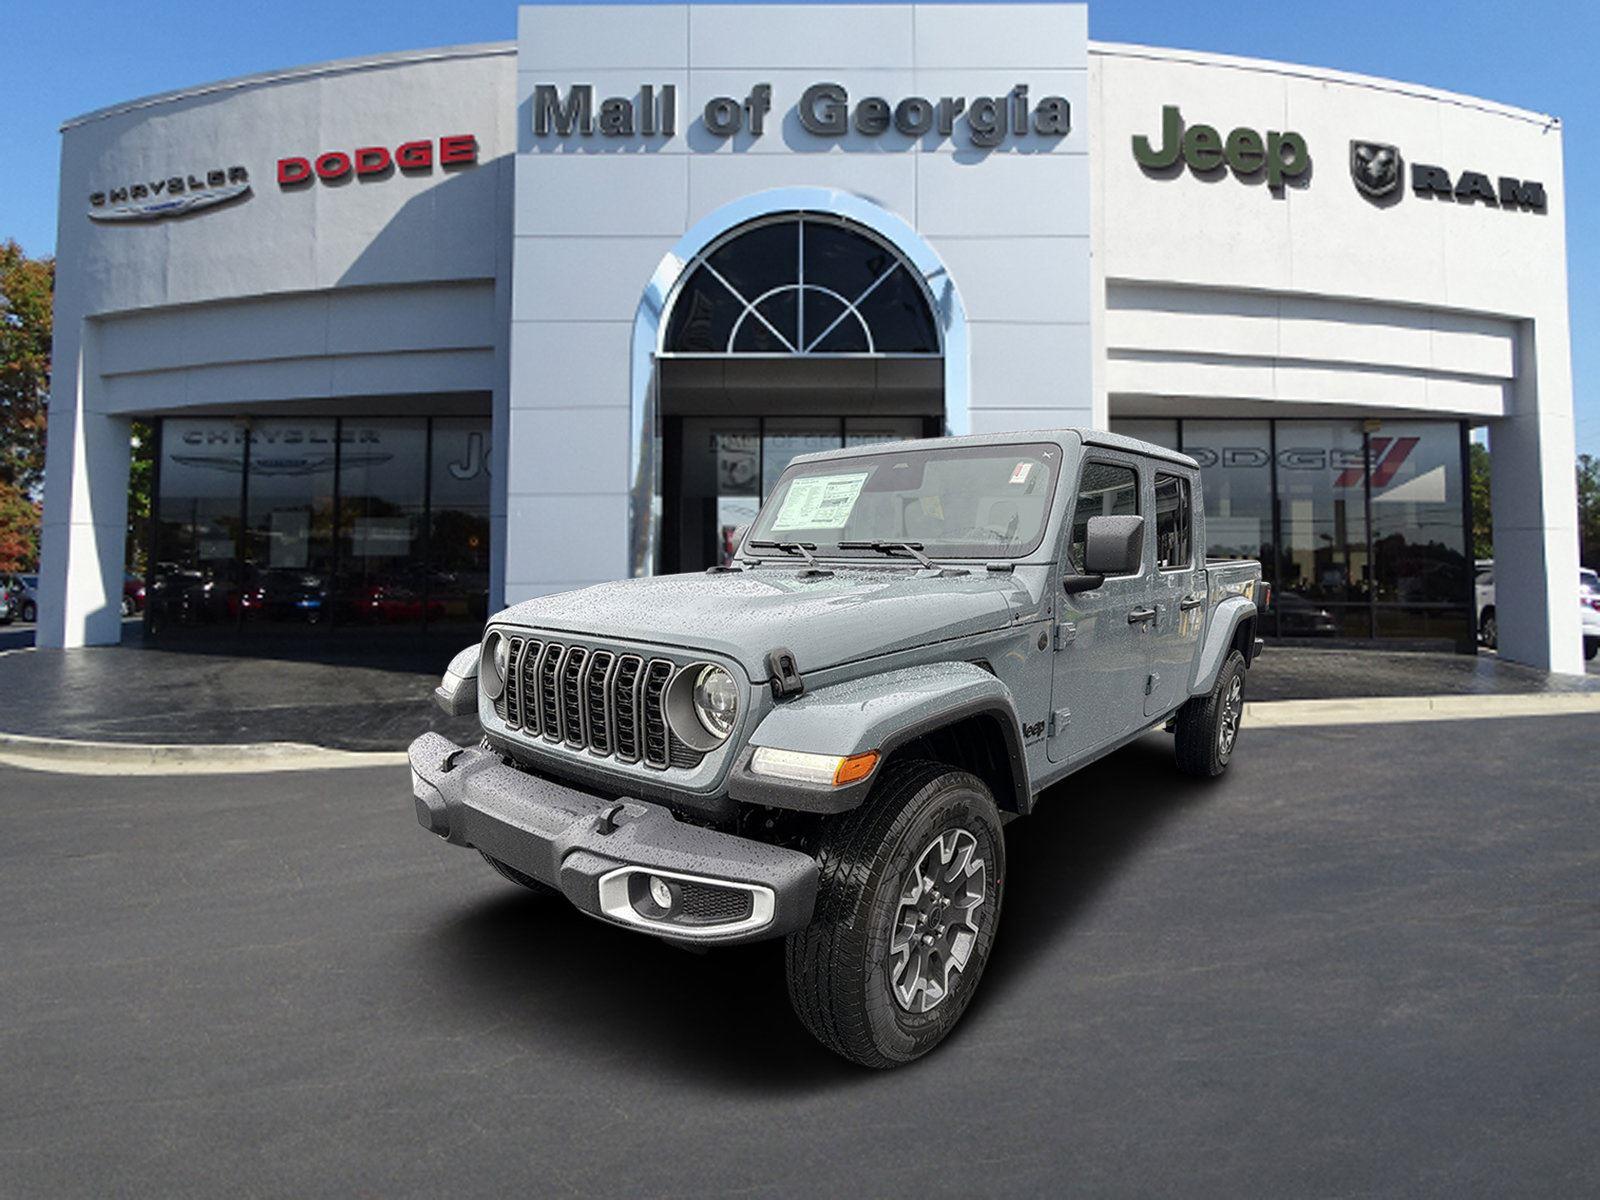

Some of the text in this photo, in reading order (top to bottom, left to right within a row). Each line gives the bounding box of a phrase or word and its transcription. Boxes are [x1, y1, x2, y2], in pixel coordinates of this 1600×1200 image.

[533, 82, 1072, 148] Mall of Georgia
[277, 134, 476, 184] DODGE
[1131, 104, 1309, 187] Jeep
[90, 166, 249, 206] CHRYSLER
[1411, 162, 1546, 211] RAM
